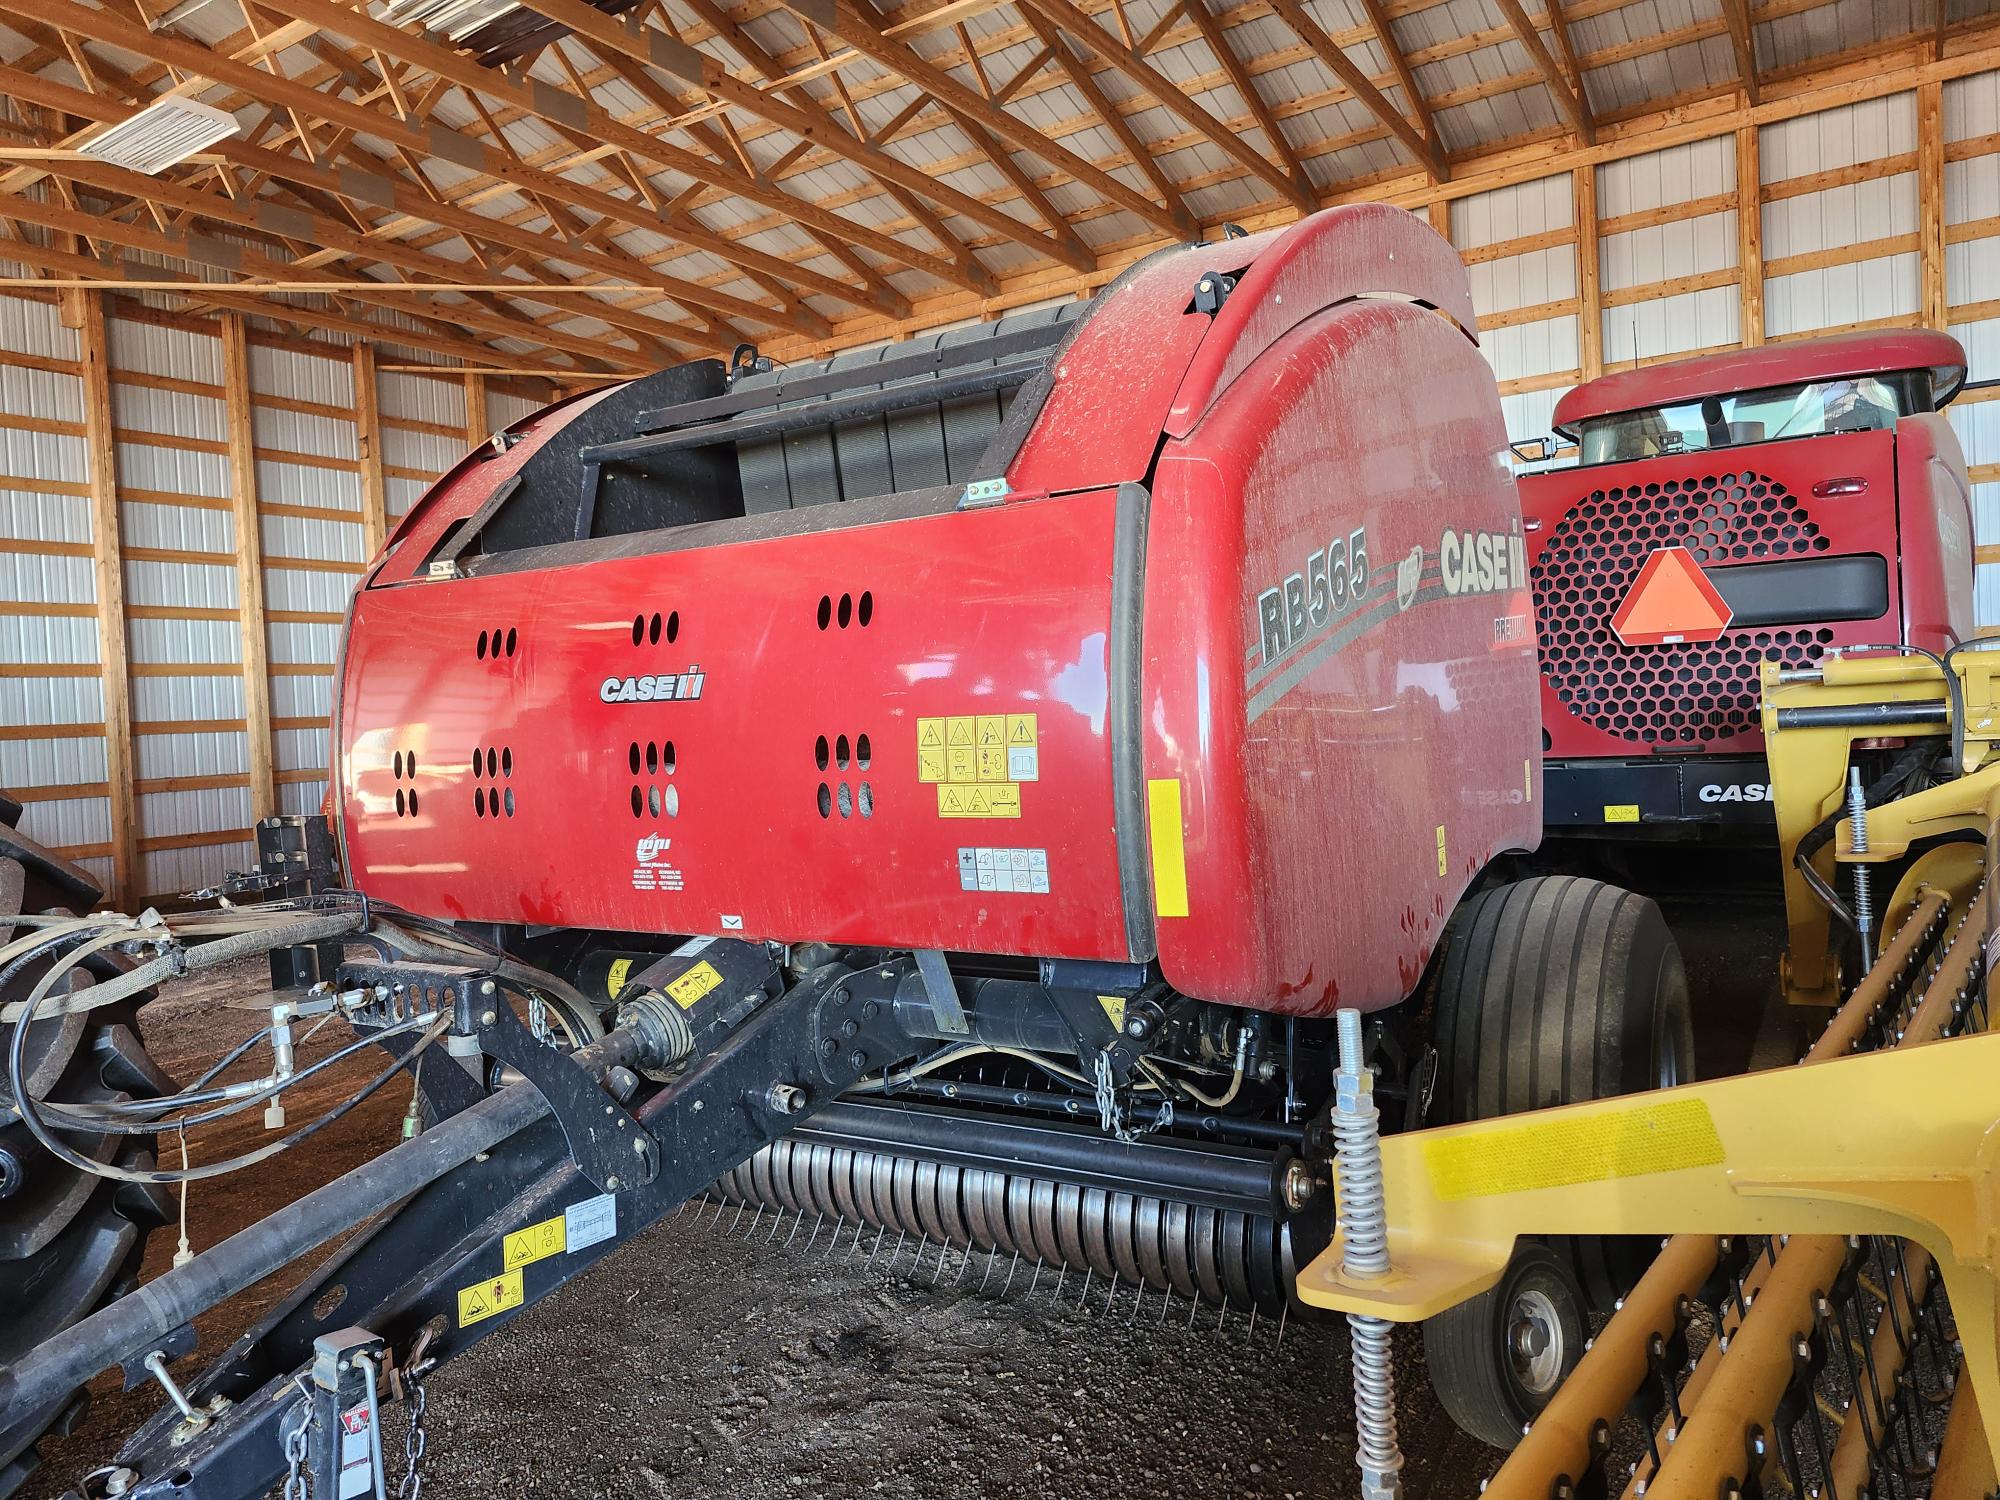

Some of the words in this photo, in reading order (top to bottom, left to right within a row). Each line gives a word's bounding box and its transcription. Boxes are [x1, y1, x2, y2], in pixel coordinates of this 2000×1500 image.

[1440, 529, 1508, 595] CASE
[1257, 524, 1370, 668] RB565
[600, 675, 676, 703] CASE
